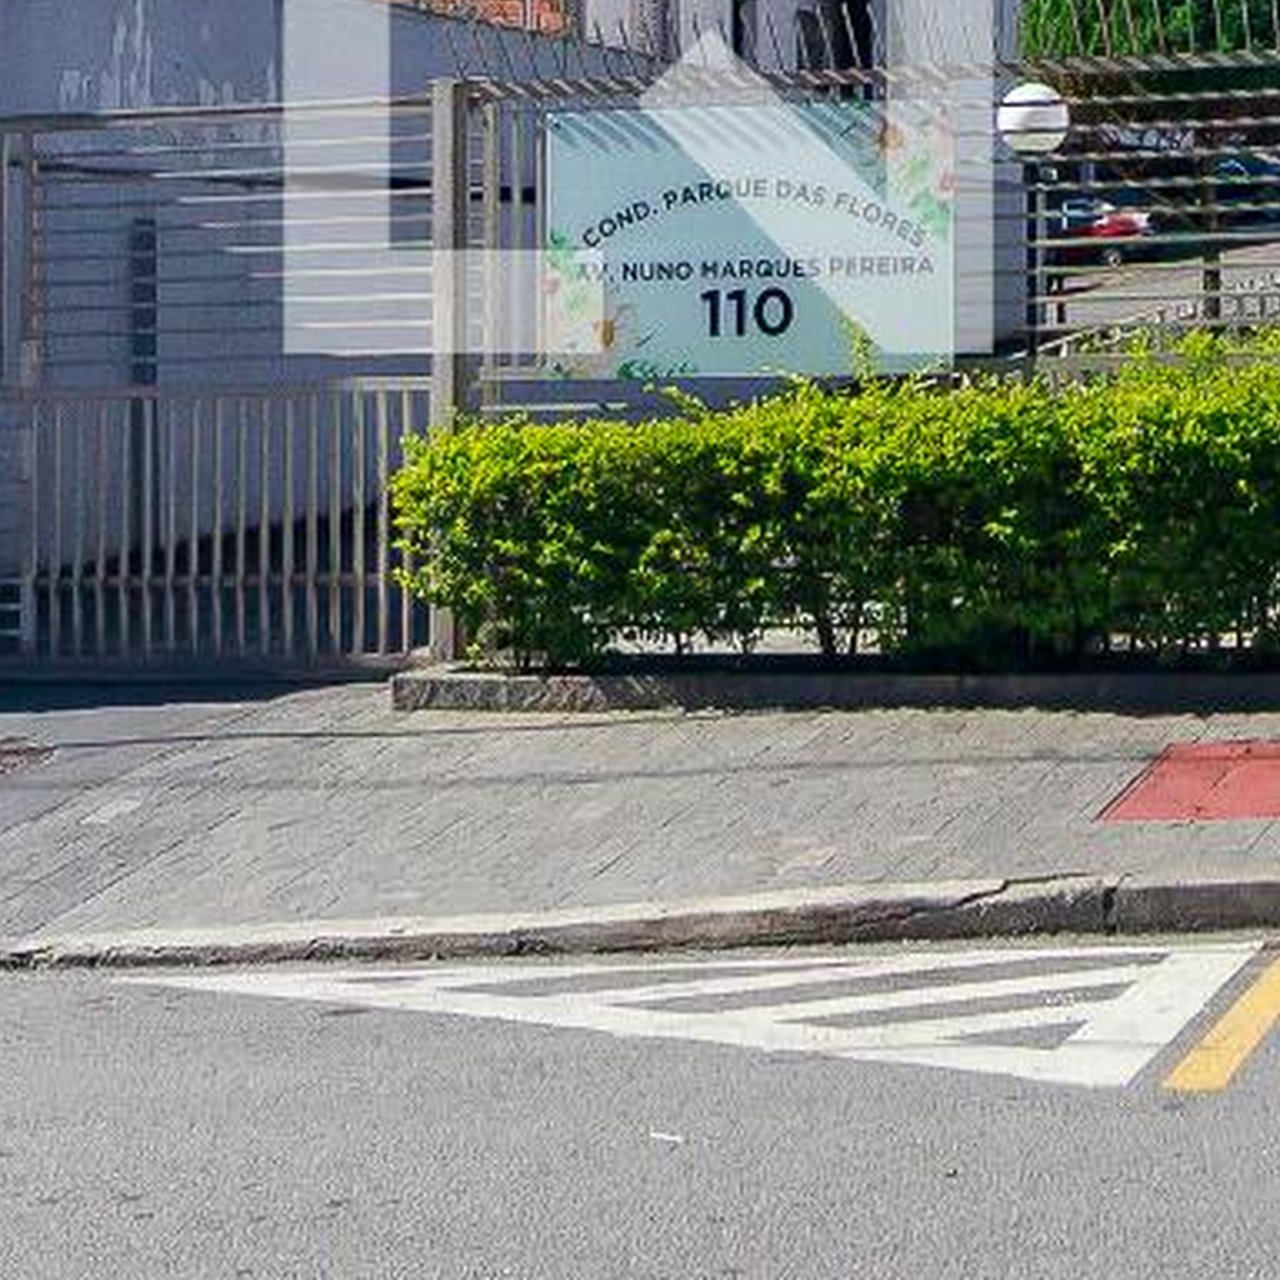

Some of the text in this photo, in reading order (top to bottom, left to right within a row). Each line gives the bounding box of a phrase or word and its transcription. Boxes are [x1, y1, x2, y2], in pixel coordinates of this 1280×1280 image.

[582, 178, 927, 249] COND. PARQUE DAS FLORES
[622, 262, 694, 281] NUNO
[700, 257, 820, 280] MARQUES
[829, 255, 936, 277] PEREIRA
[699, 286, 794, 338] 110
